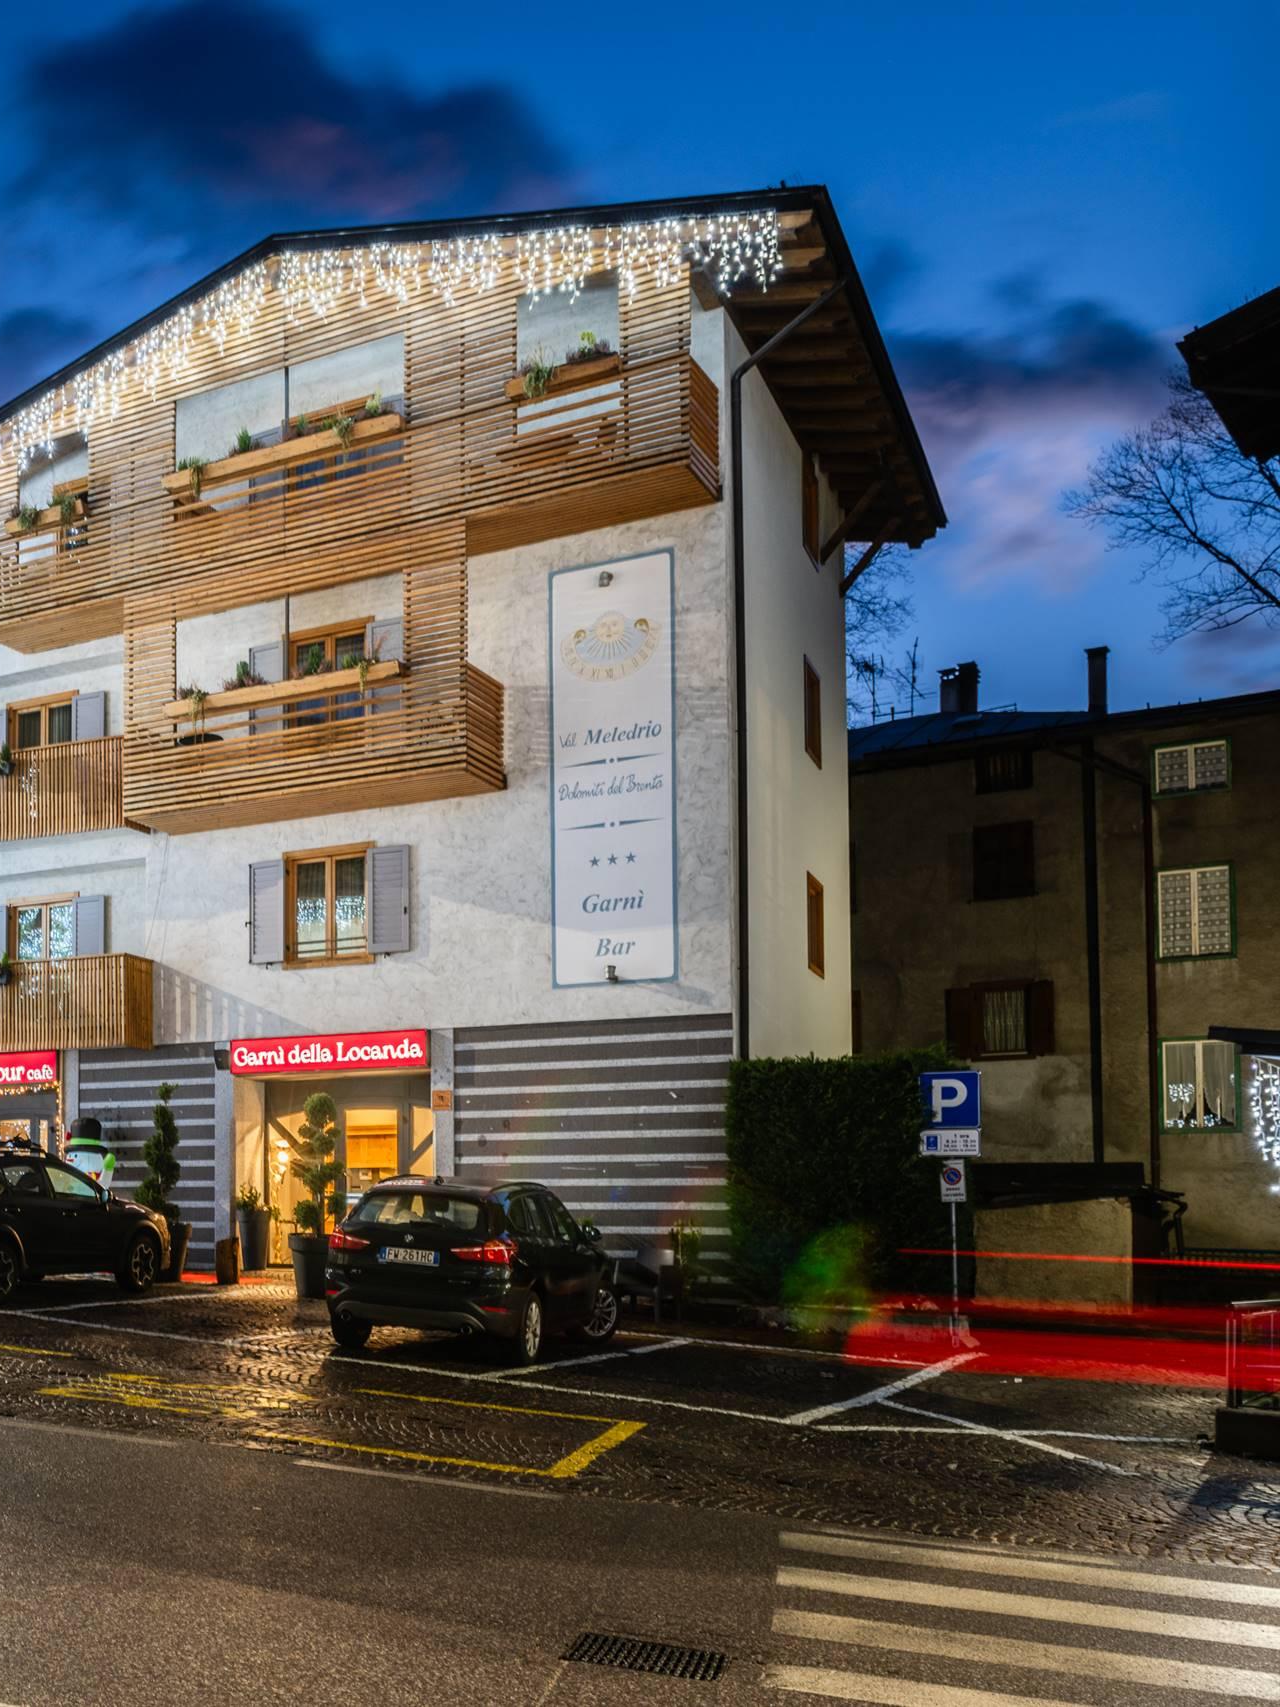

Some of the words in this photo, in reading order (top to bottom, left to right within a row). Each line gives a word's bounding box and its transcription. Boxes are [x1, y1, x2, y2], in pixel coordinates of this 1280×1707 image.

[559, 731, 577, 749] Val
[583, 719, 663, 746] Meledrio
[559, 781, 606, 802] Dolomiti
[607, 775, 625, 796] del
[625, 774, 664, 793] Brenta
[581, 889, 645, 914] Garnì
[595, 938, 636, 957] Bar
[233, 1045, 285, 1067] Garnì
[287, 1043, 333, 1065] della
[336, 1037, 424, 1062] Locanda
[931, 1078, 969, 1124] P
[402, 1249, 433, 1263] 261HC
